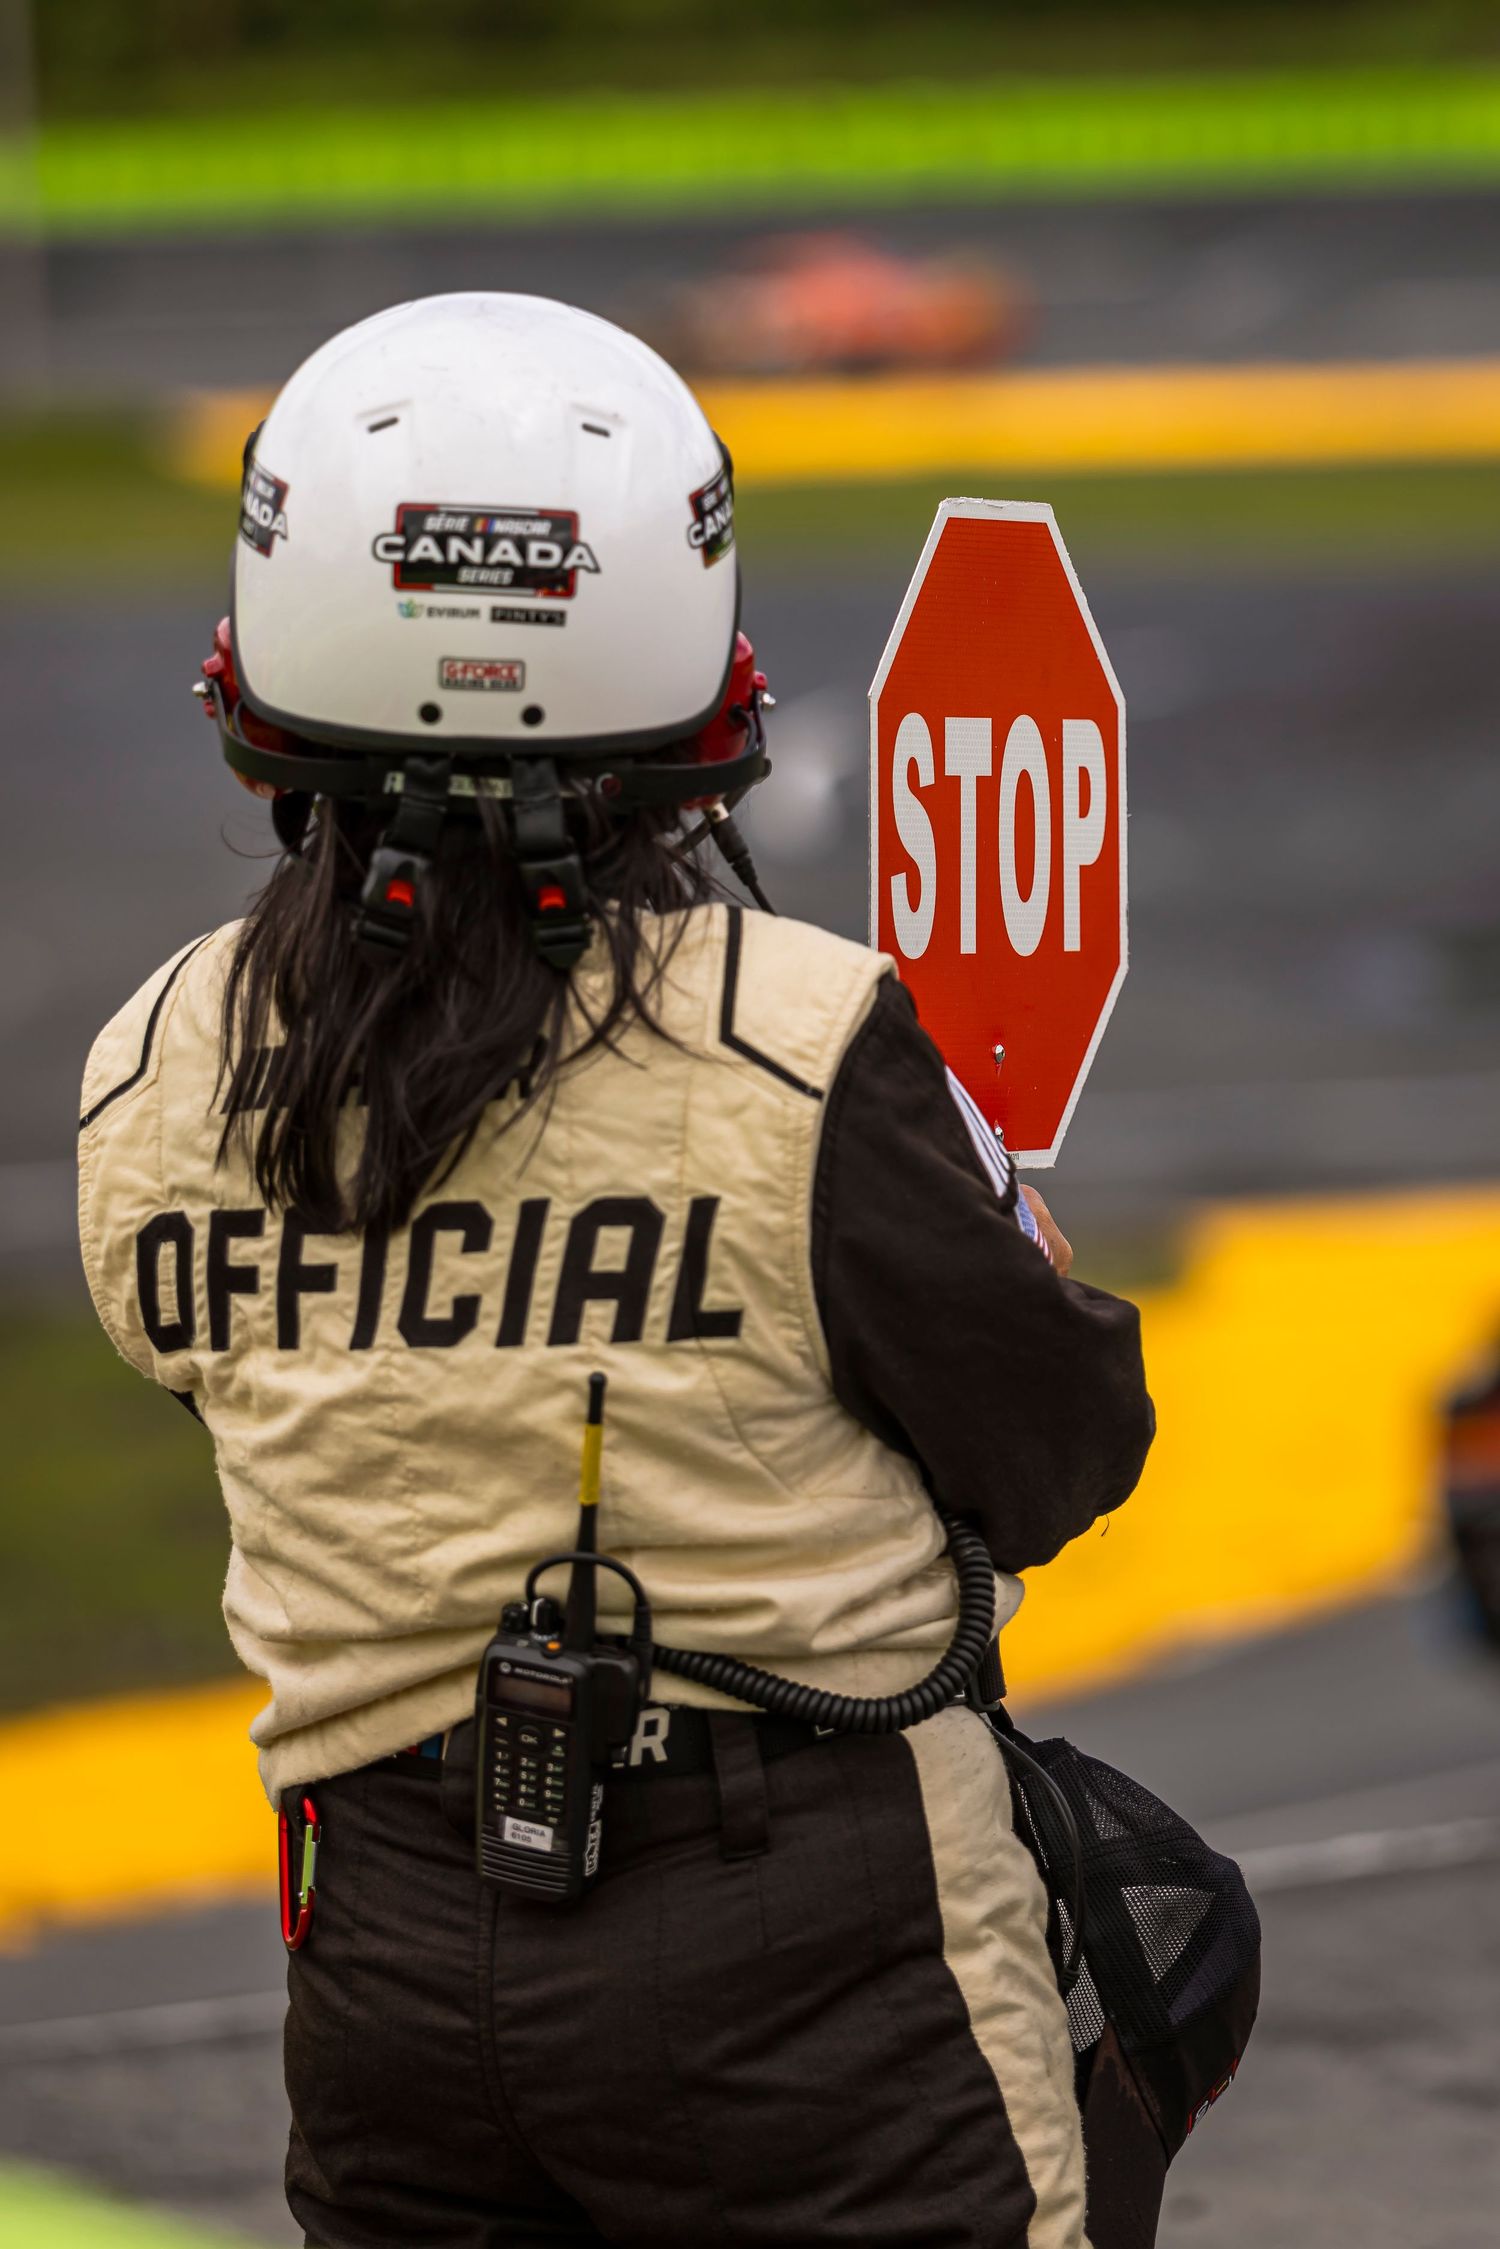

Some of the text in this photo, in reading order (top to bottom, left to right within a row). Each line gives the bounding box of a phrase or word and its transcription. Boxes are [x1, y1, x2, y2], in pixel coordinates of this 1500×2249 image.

[492, 518, 552, 536] NASCAR
[374, 535, 599, 571] CANADA
[458, 568, 514, 585] SERIES
[890, 712, 1107, 960] STOP
[136, 1195, 744, 1353] OFFICIAL
[514, 1667, 570, 1684] MOTOROLA
[520, 1733, 539, 1745] OK
[512, 1823, 545, 1838] GLORIA
